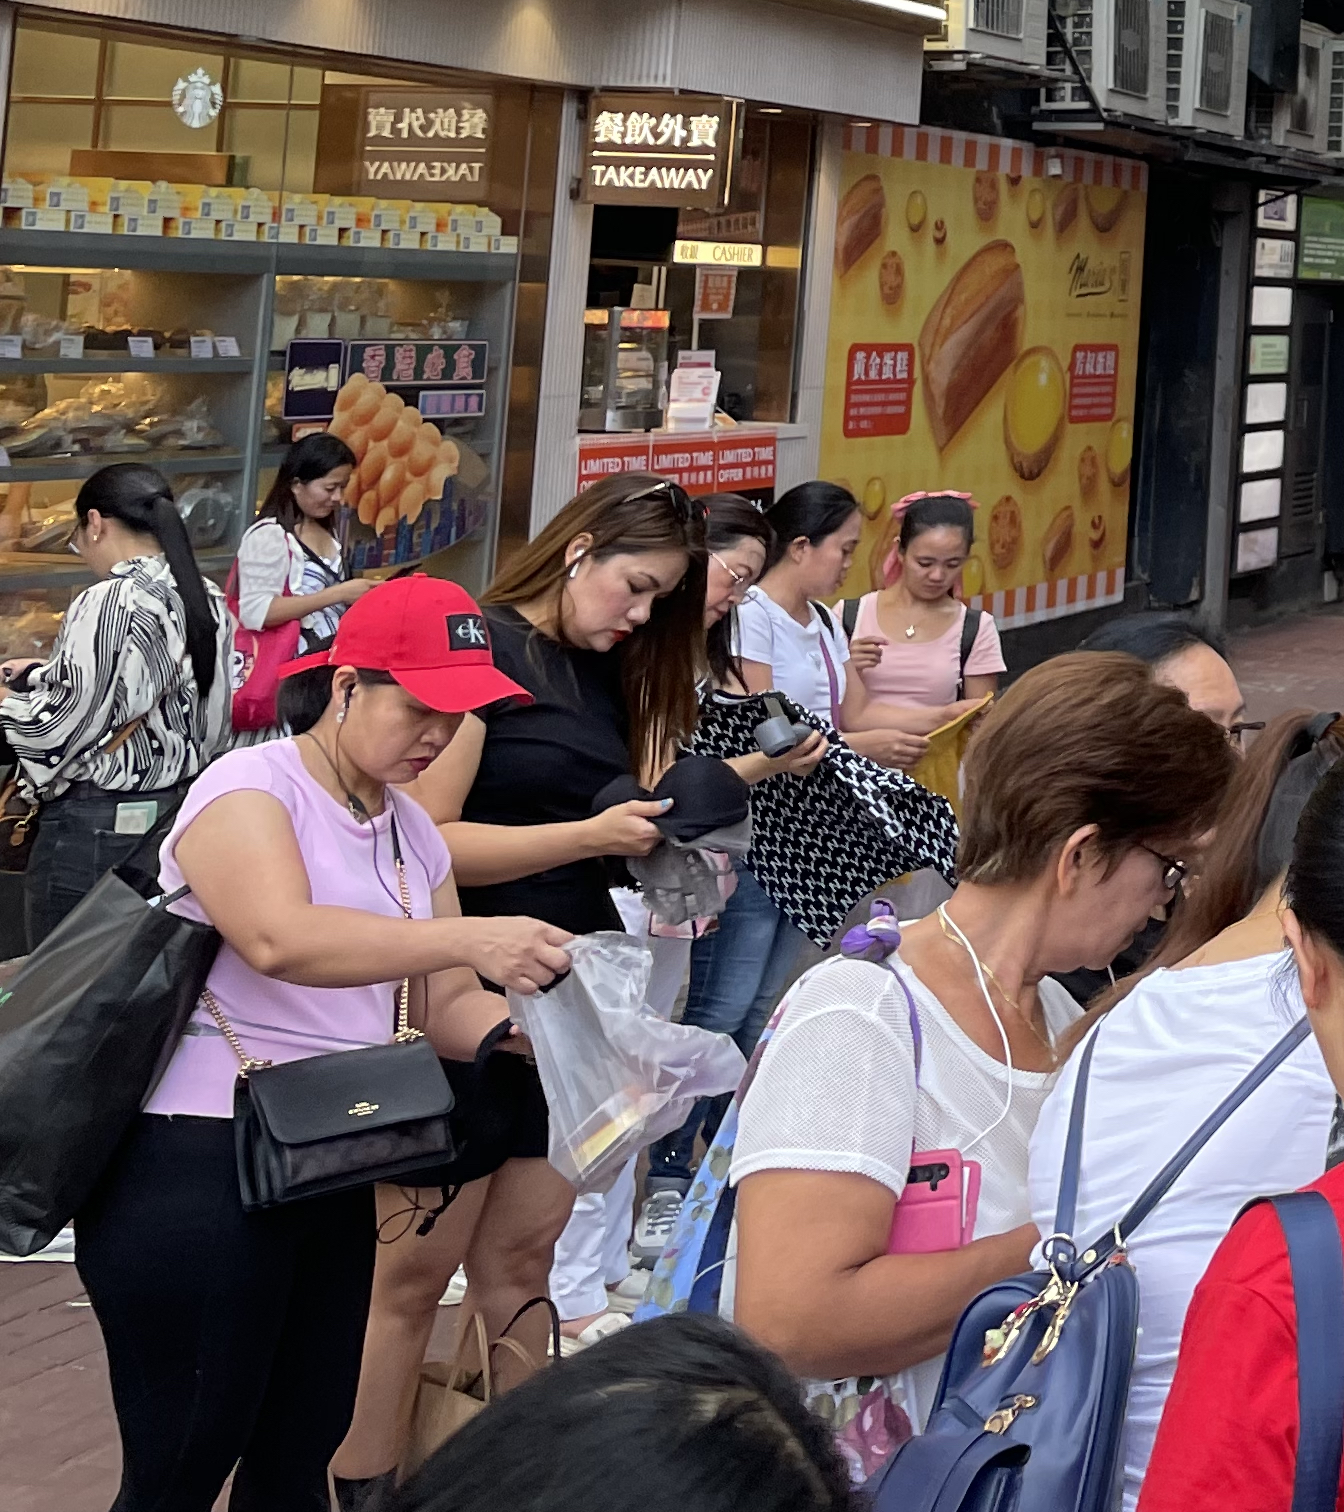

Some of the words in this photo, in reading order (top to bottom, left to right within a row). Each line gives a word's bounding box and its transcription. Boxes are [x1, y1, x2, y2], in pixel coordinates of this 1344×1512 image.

[593, 110, 720, 148] 餐飲外賣
[591, 163, 714, 191] TAKEAWAY
[713, 245, 754, 263] CASHIER
[581, 457, 622, 475] LIMITED
[623, 455, 647, 471] TIME
[653, 452, 690, 470] LIMITED
[692, 450, 714, 466] TIME
[718, 448, 754, 465] LIMITED
[754, 446, 774, 461] TIME
